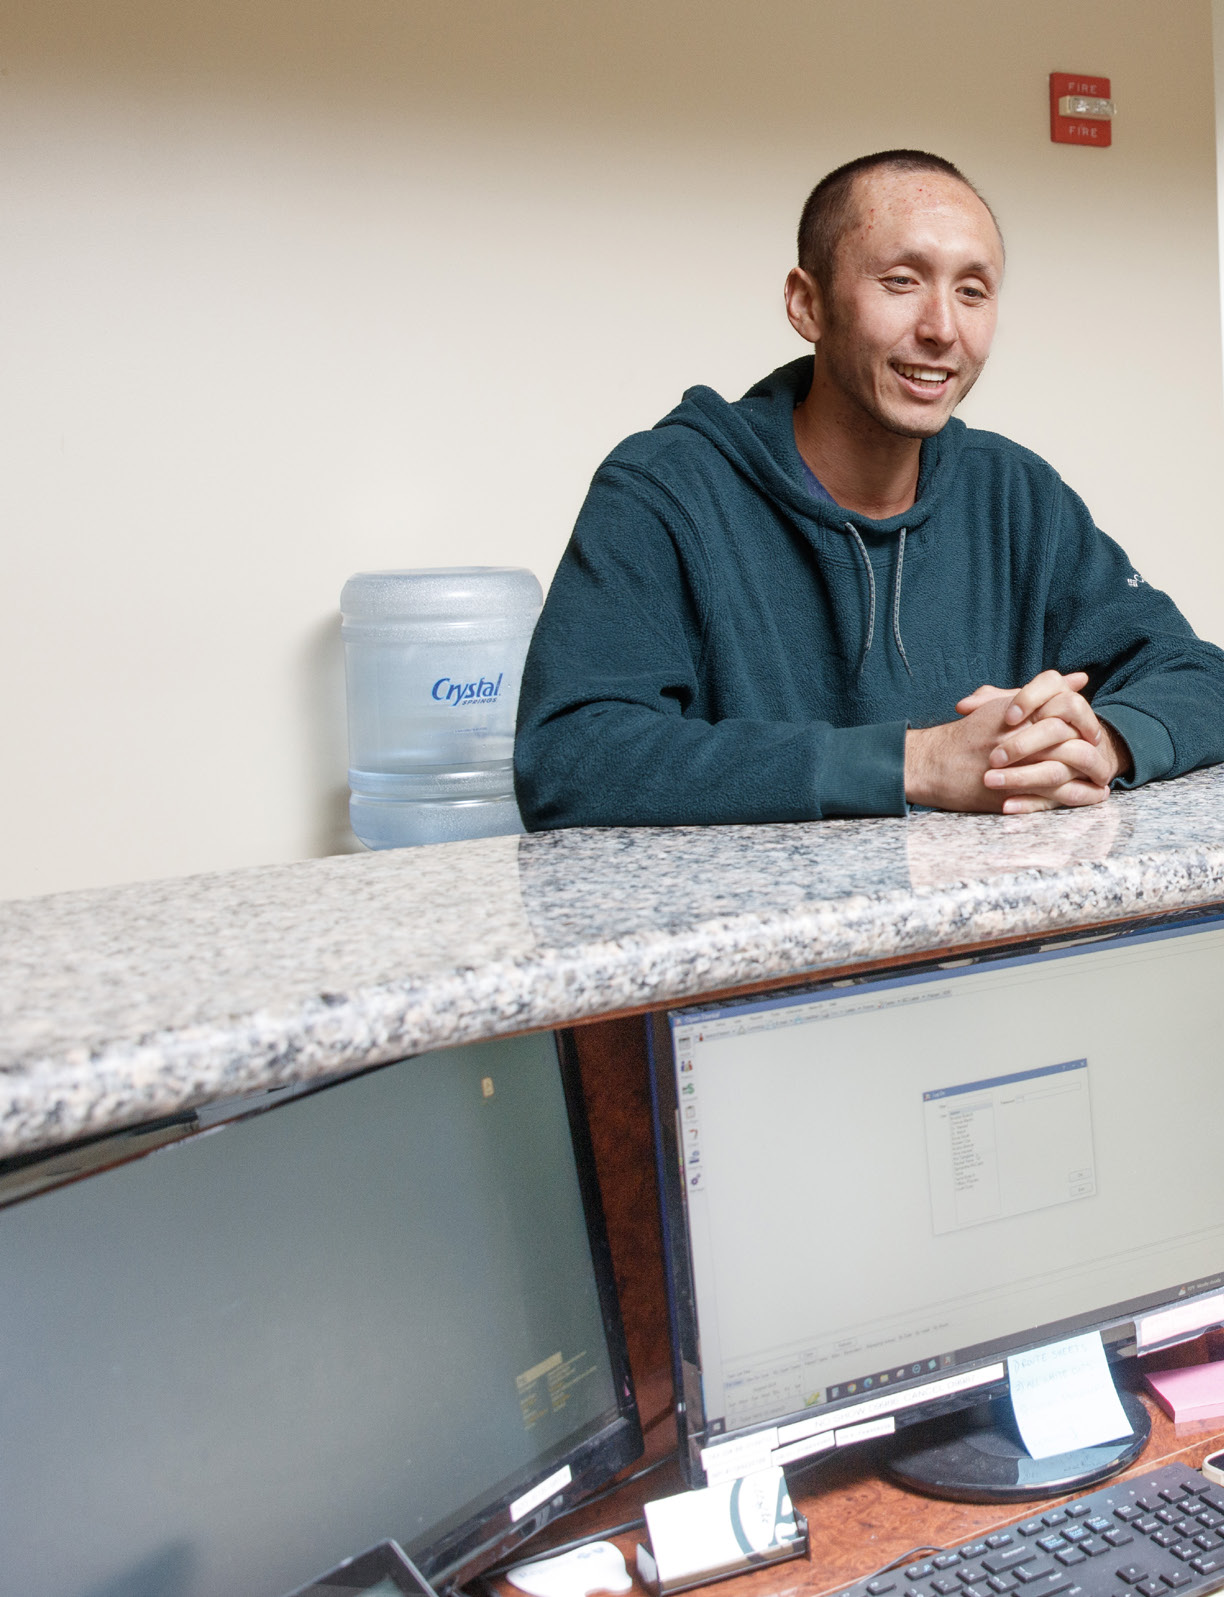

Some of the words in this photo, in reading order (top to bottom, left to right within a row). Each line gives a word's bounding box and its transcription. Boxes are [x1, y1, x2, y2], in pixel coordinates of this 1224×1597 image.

[1068, 82, 1097, 94] FIRE
[1069, 125, 1098, 138] FIRE
[431, 672, 503, 706] Crystal
[462, 697, 497, 706] SPRINGS
[814, 1416, 830, 1429] NO
[833, 1407, 865, 1423] SHOW
